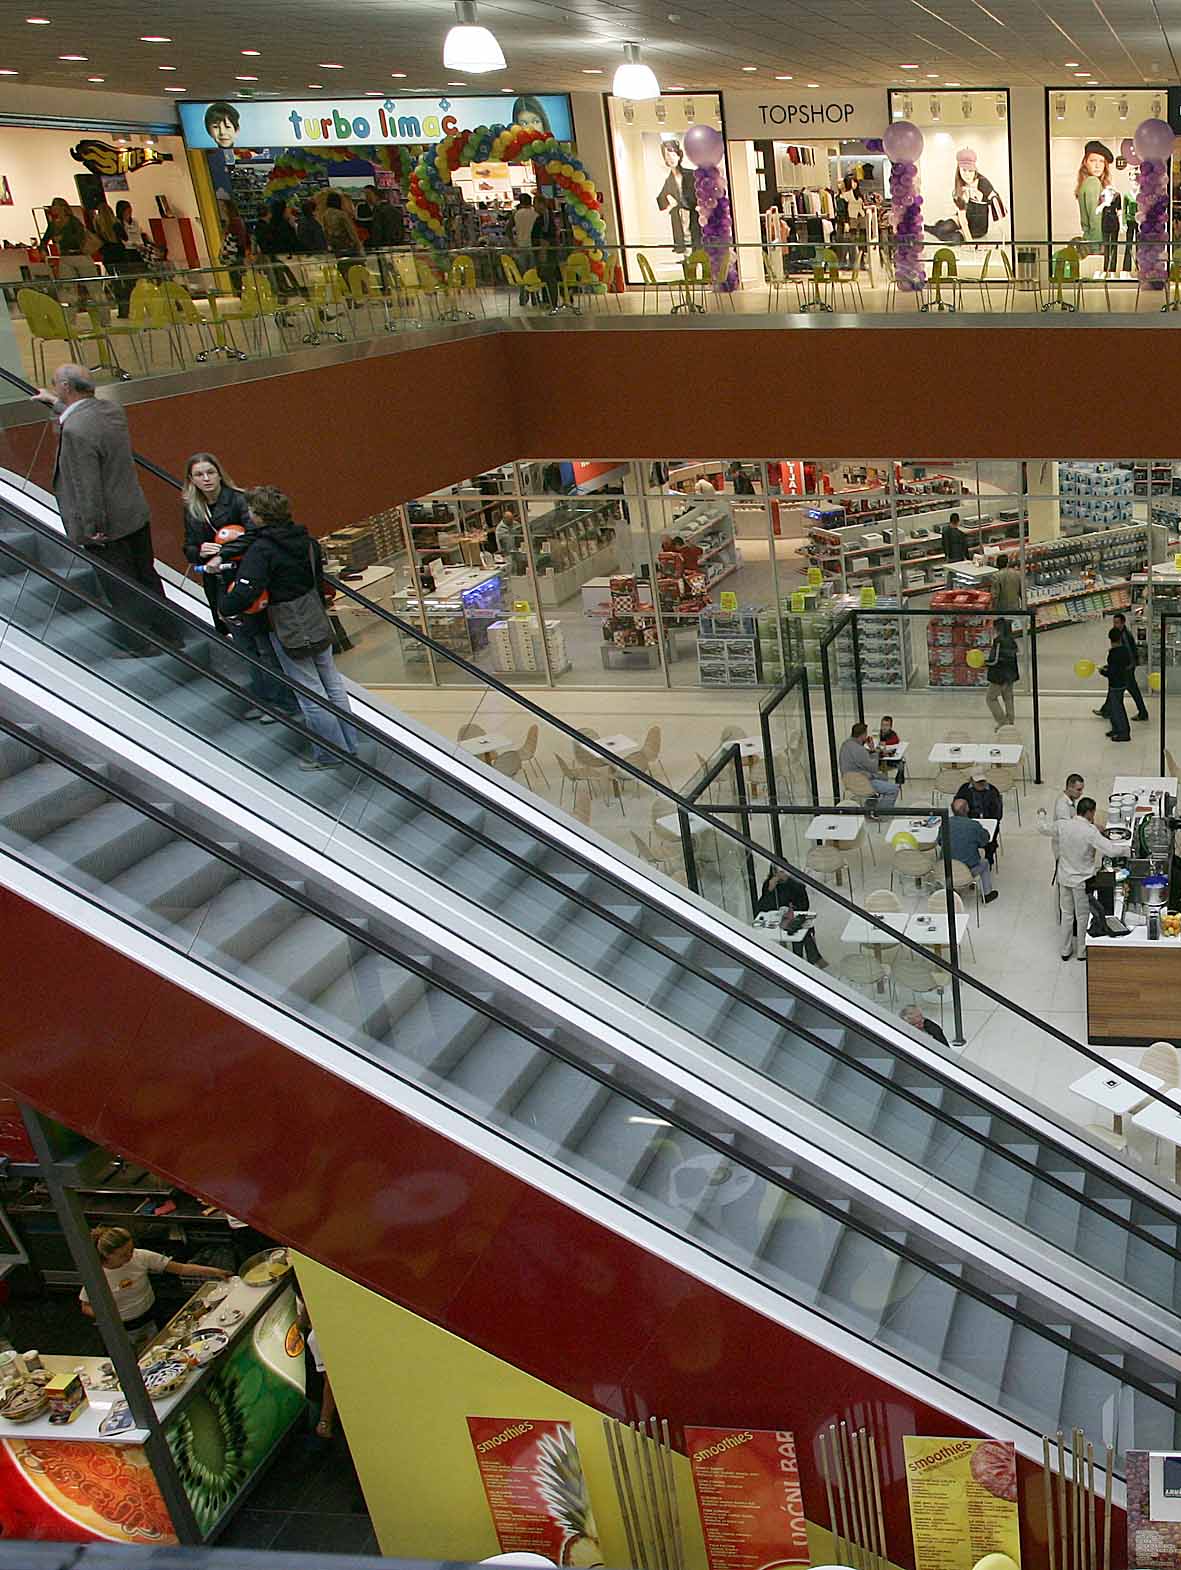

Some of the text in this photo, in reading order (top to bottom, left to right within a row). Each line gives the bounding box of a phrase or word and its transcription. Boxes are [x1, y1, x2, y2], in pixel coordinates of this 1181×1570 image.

[288, 110, 371, 140] turbo
[758, 103, 854, 125] TOPSHOP
[476, 1420, 534, 1454] smoothies
[692, 1431, 754, 1462] smoothies
[908, 1440, 972, 1472] smoothies
